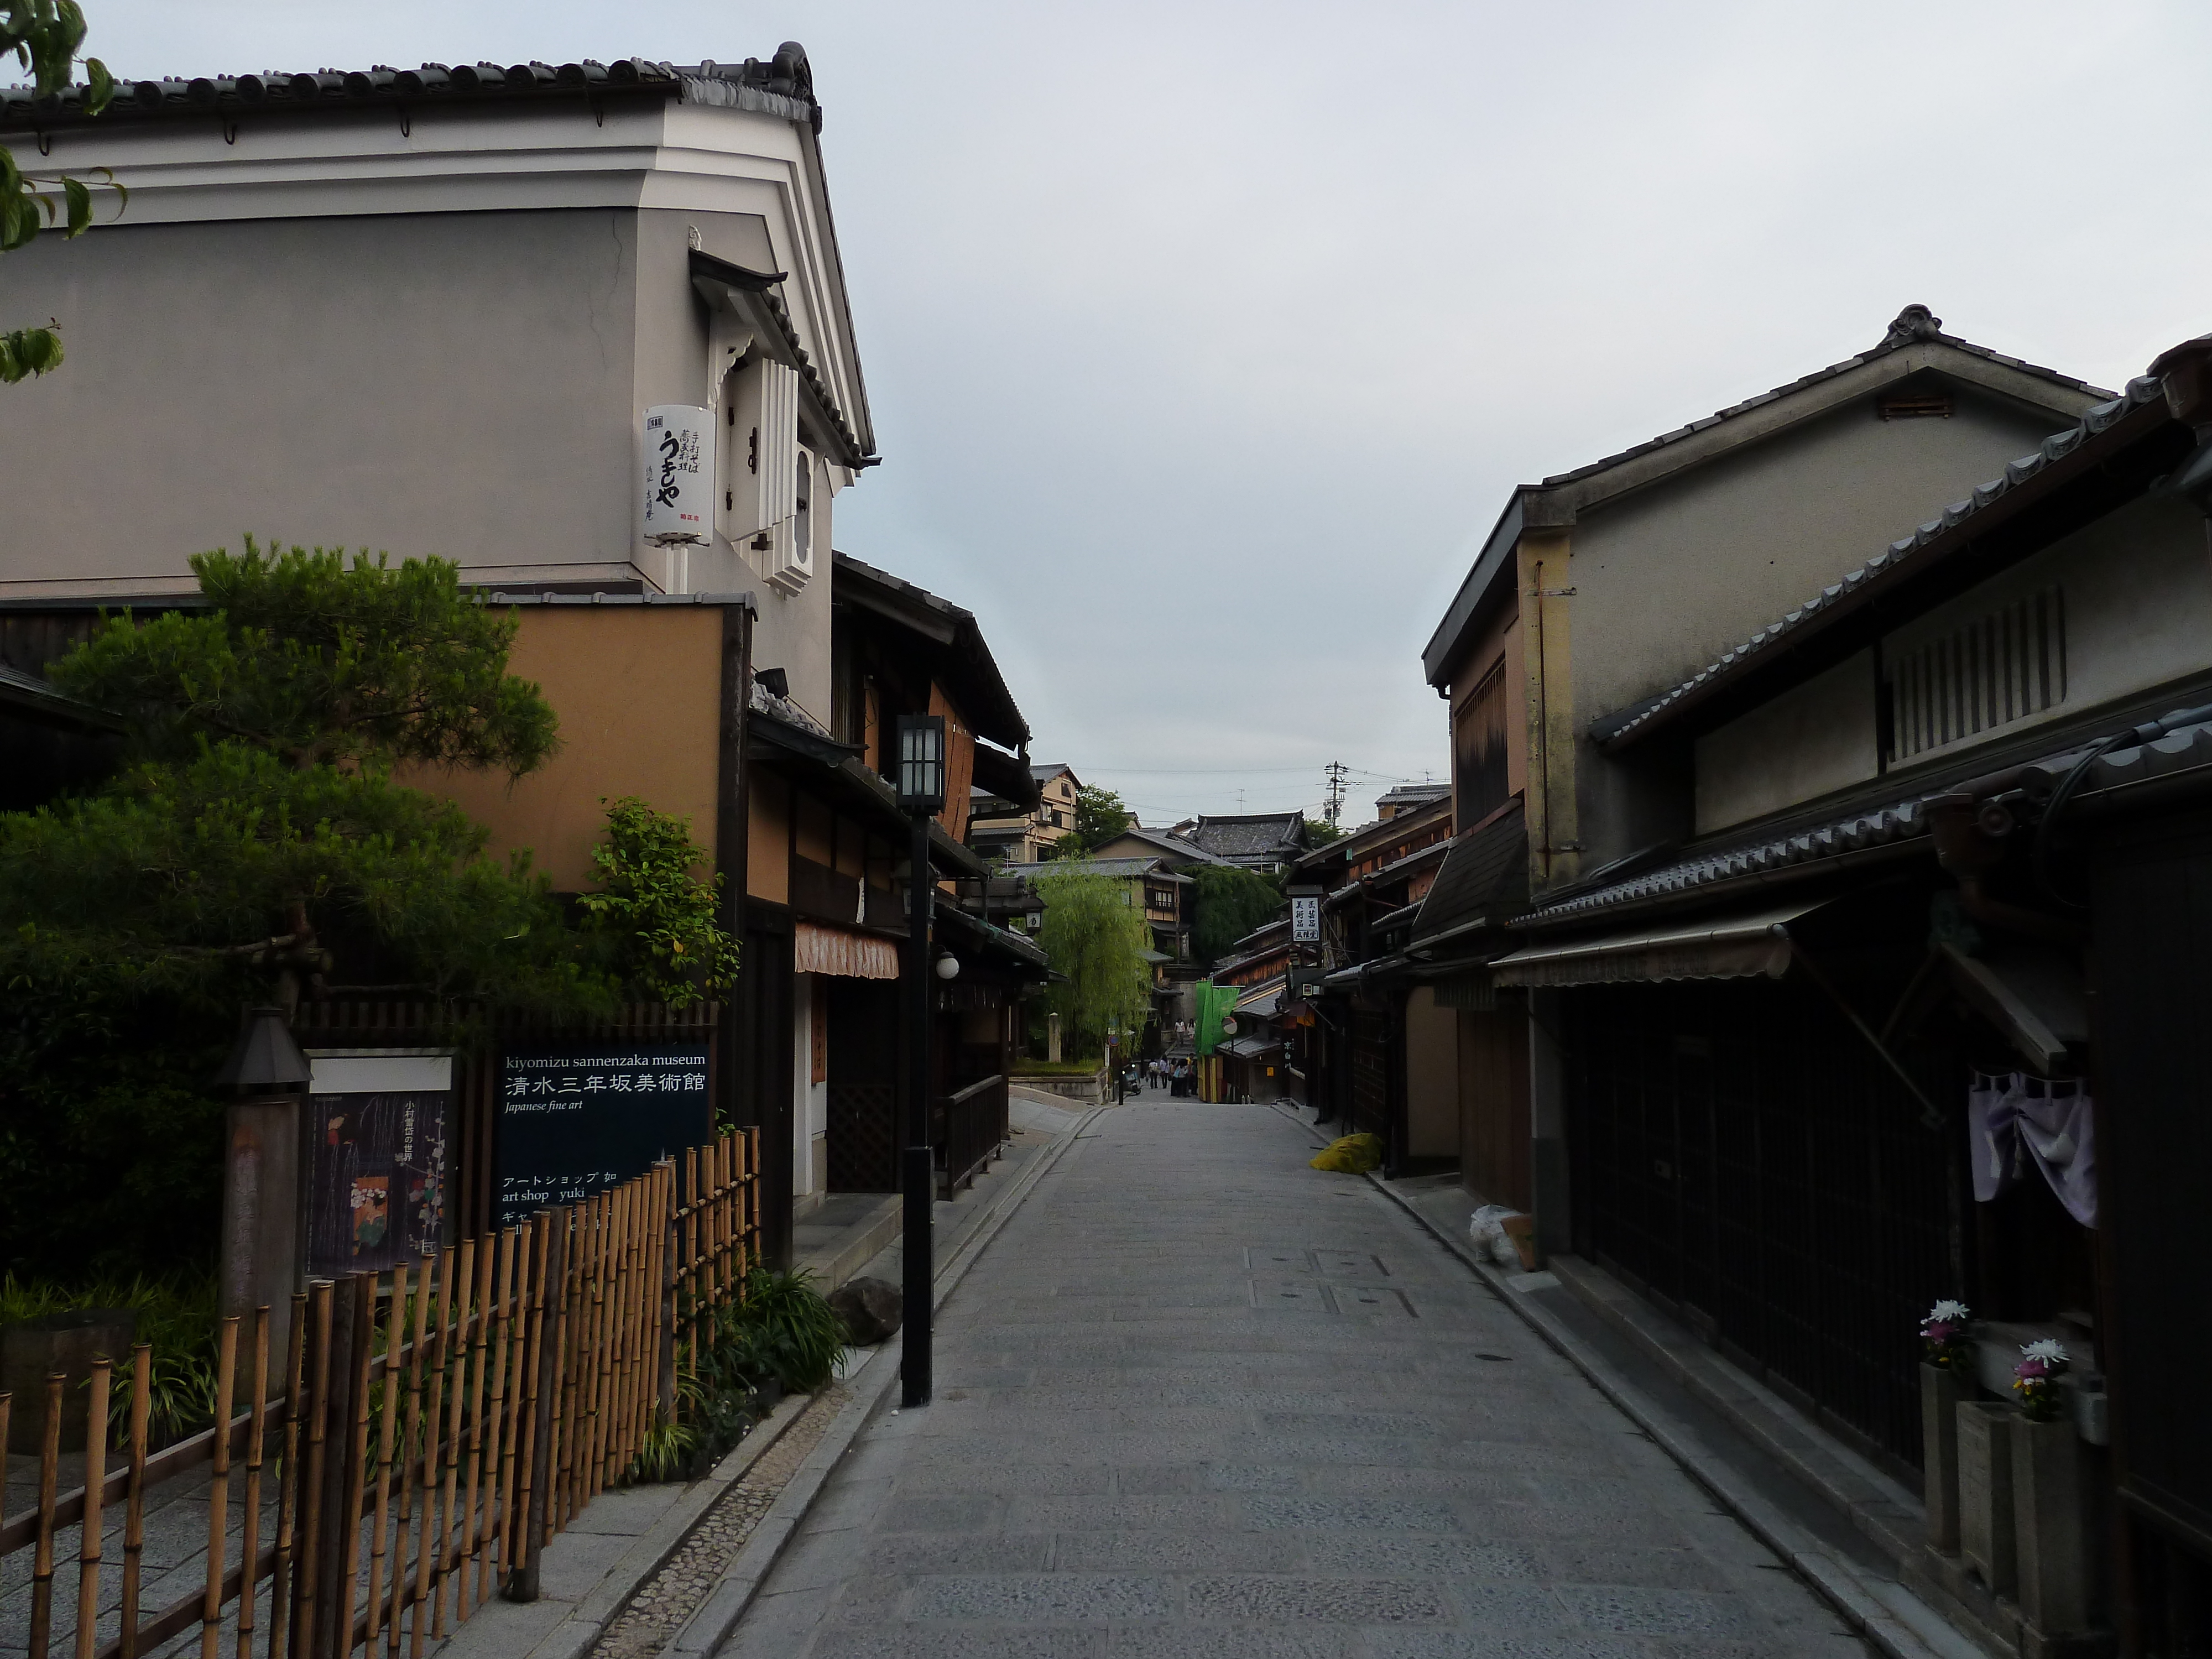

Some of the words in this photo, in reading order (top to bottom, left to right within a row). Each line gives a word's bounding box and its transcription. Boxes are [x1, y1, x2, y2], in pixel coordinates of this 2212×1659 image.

[688, 432, 701, 473] 手打そば
[505, 1056, 569, 1071] kiyomizu
[573, 1054, 649, 1067] sannenzaka
[651, 1055, 706, 1066] museum
[505, 1072, 706, 1095] 清水三年坂美術館
[504, 1101, 546, 1114] Japanese
[547, 1100, 566, 1113] fine
[568, 1100, 583, 1110] art
[503, 1171, 599, 1187] アートショップ
[603, 1171, 617, 1183] 如
[502, 1191, 519, 1202] art
[521, 1190, 549, 1203] shop
[559, 1187, 585, 1202] yuki
